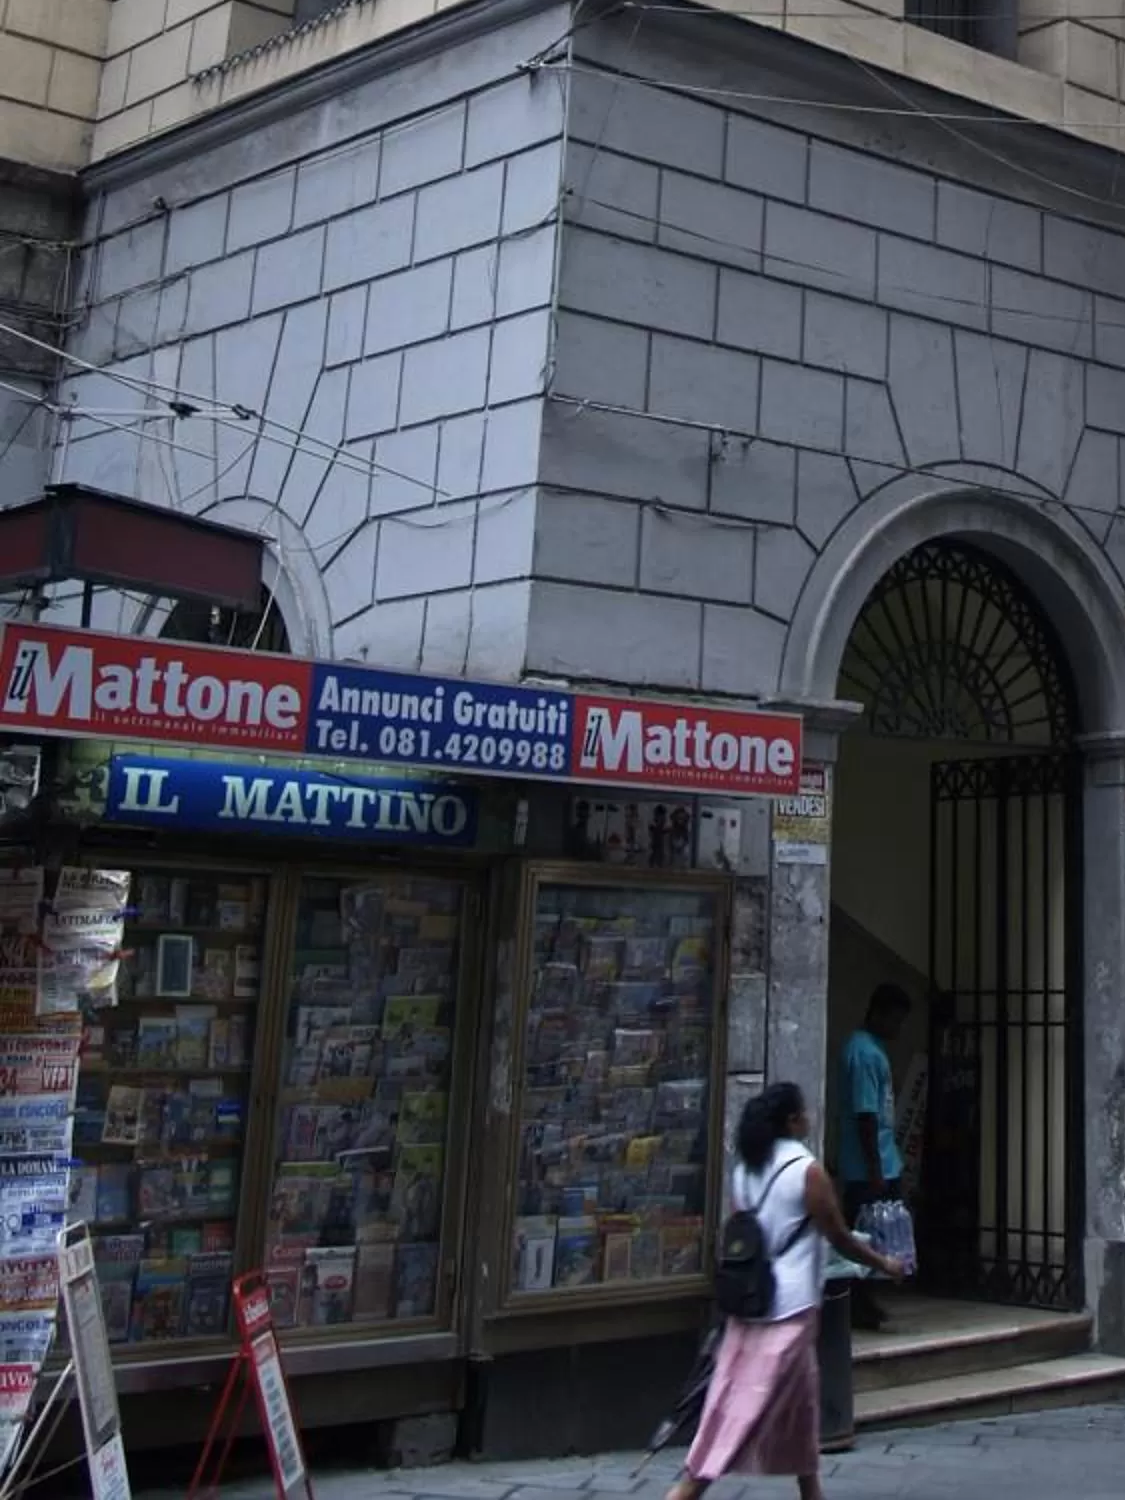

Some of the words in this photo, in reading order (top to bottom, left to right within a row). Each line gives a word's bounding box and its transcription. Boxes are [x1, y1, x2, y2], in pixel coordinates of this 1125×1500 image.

[4, 639, 301, 729] Mattone
[317, 675, 445, 723] Annunci
[453, 691, 569, 736] Gratuiti
[316, 719, 369, 753] Tel.
[379, 725, 566, 771] 081.4209988
[580, 707, 795, 777] Mattone
[117, 767, 180, 814] IL
[217, 774, 468, 836] MATTINO
